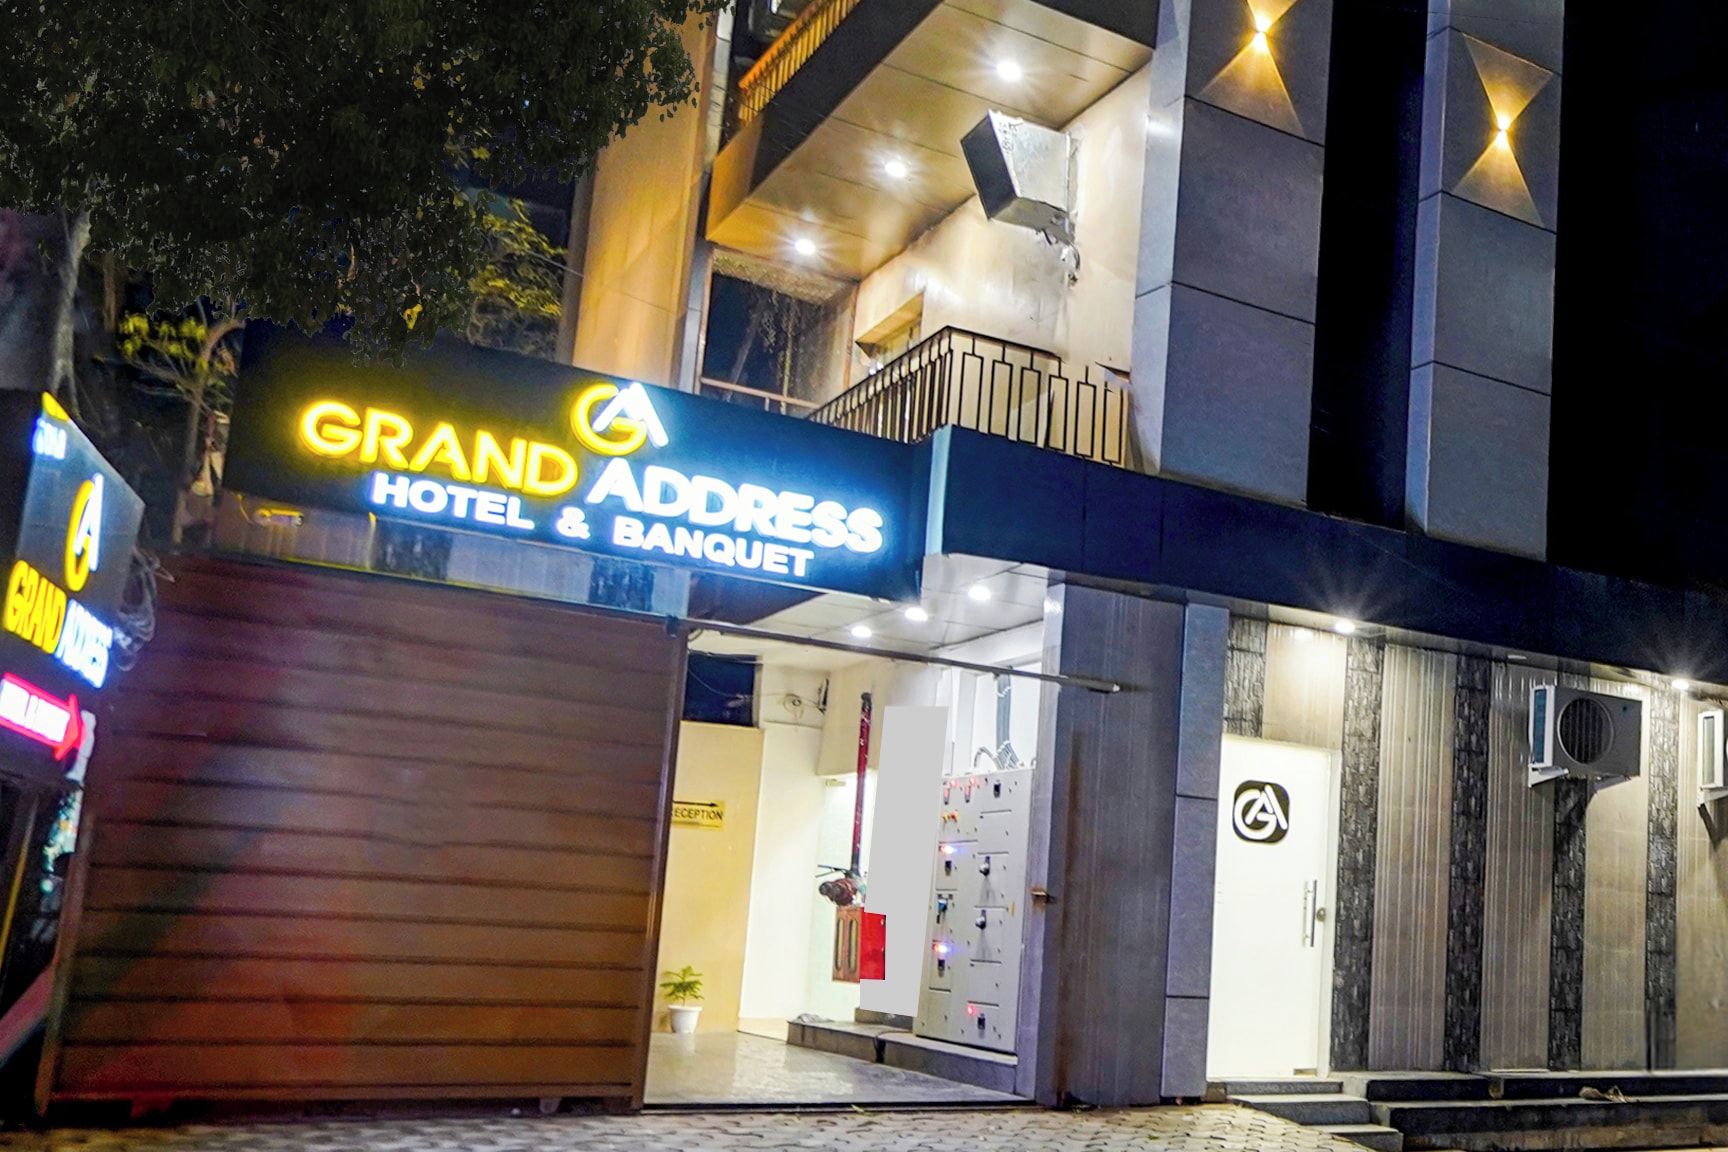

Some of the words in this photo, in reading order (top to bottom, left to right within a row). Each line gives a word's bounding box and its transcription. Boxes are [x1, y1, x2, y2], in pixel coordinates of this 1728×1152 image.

[299, 400, 579, 497] GRAND
[585, 456, 884, 553] ADDRESS
[370, 472, 536, 530] HOTEL
[556, 505, 592, 540] &
[613, 515, 815, 577] BANQUET
[3, 559, 68, 654] GRAND
[673, 807, 724, 821] ECEPTION
